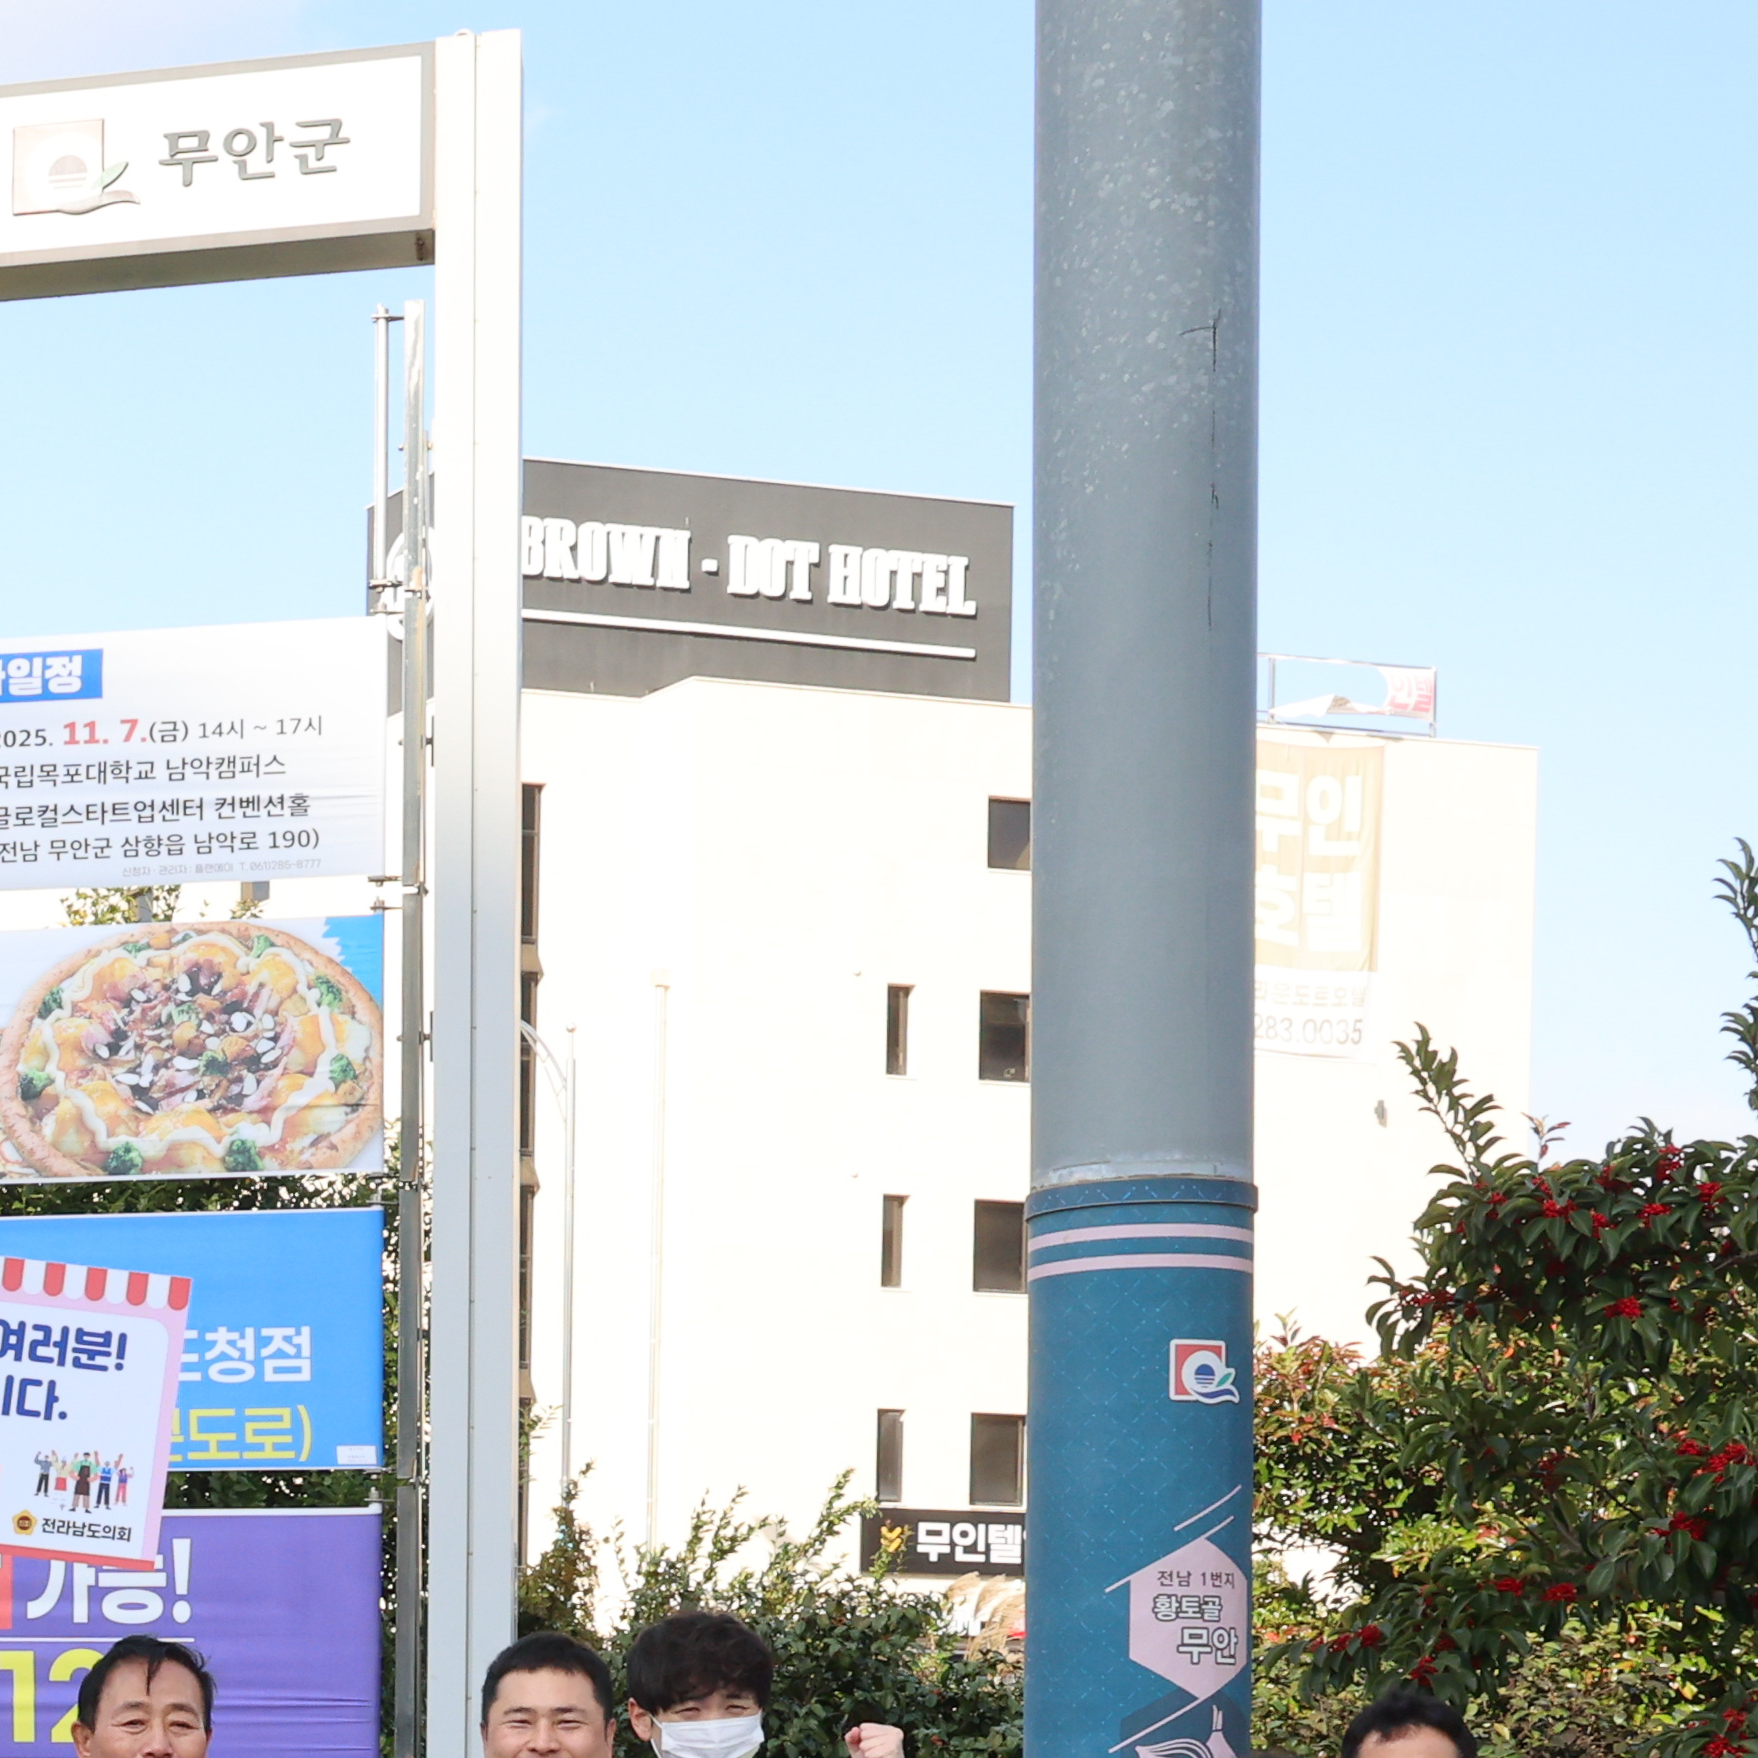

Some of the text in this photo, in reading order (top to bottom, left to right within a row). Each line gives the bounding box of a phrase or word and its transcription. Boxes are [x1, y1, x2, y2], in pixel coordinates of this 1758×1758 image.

[158, 118, 350, 187] 무안군
[521, 516, 691, 590] BROWN
[726, 535, 820, 601] DOT
[828, 545, 978, 617] HOTEL
[63, 721, 109, 746] 11.
[198, 718, 246, 740] 14시
[275, 715, 324, 737] 17시
[165, 754, 287, 782] 남악캠퍼스
[214, 793, 312, 821] 컨벤션홀
[48, 837, 112, 862] 무안군
[121, 833, 186, 859] 삼향읍
[193, 829, 259, 854] 남악로
[268, 828, 321, 850] 190)
[168, 1404, 313, 1463] 도로)
[41, 1517, 133, 1543] 전라남도의회
[1157, 1569, 1236, 1589] 전남 1번지
[1152, 1593, 1223, 1622] 황토골
[1176, 1626, 1238, 1665] 무안
